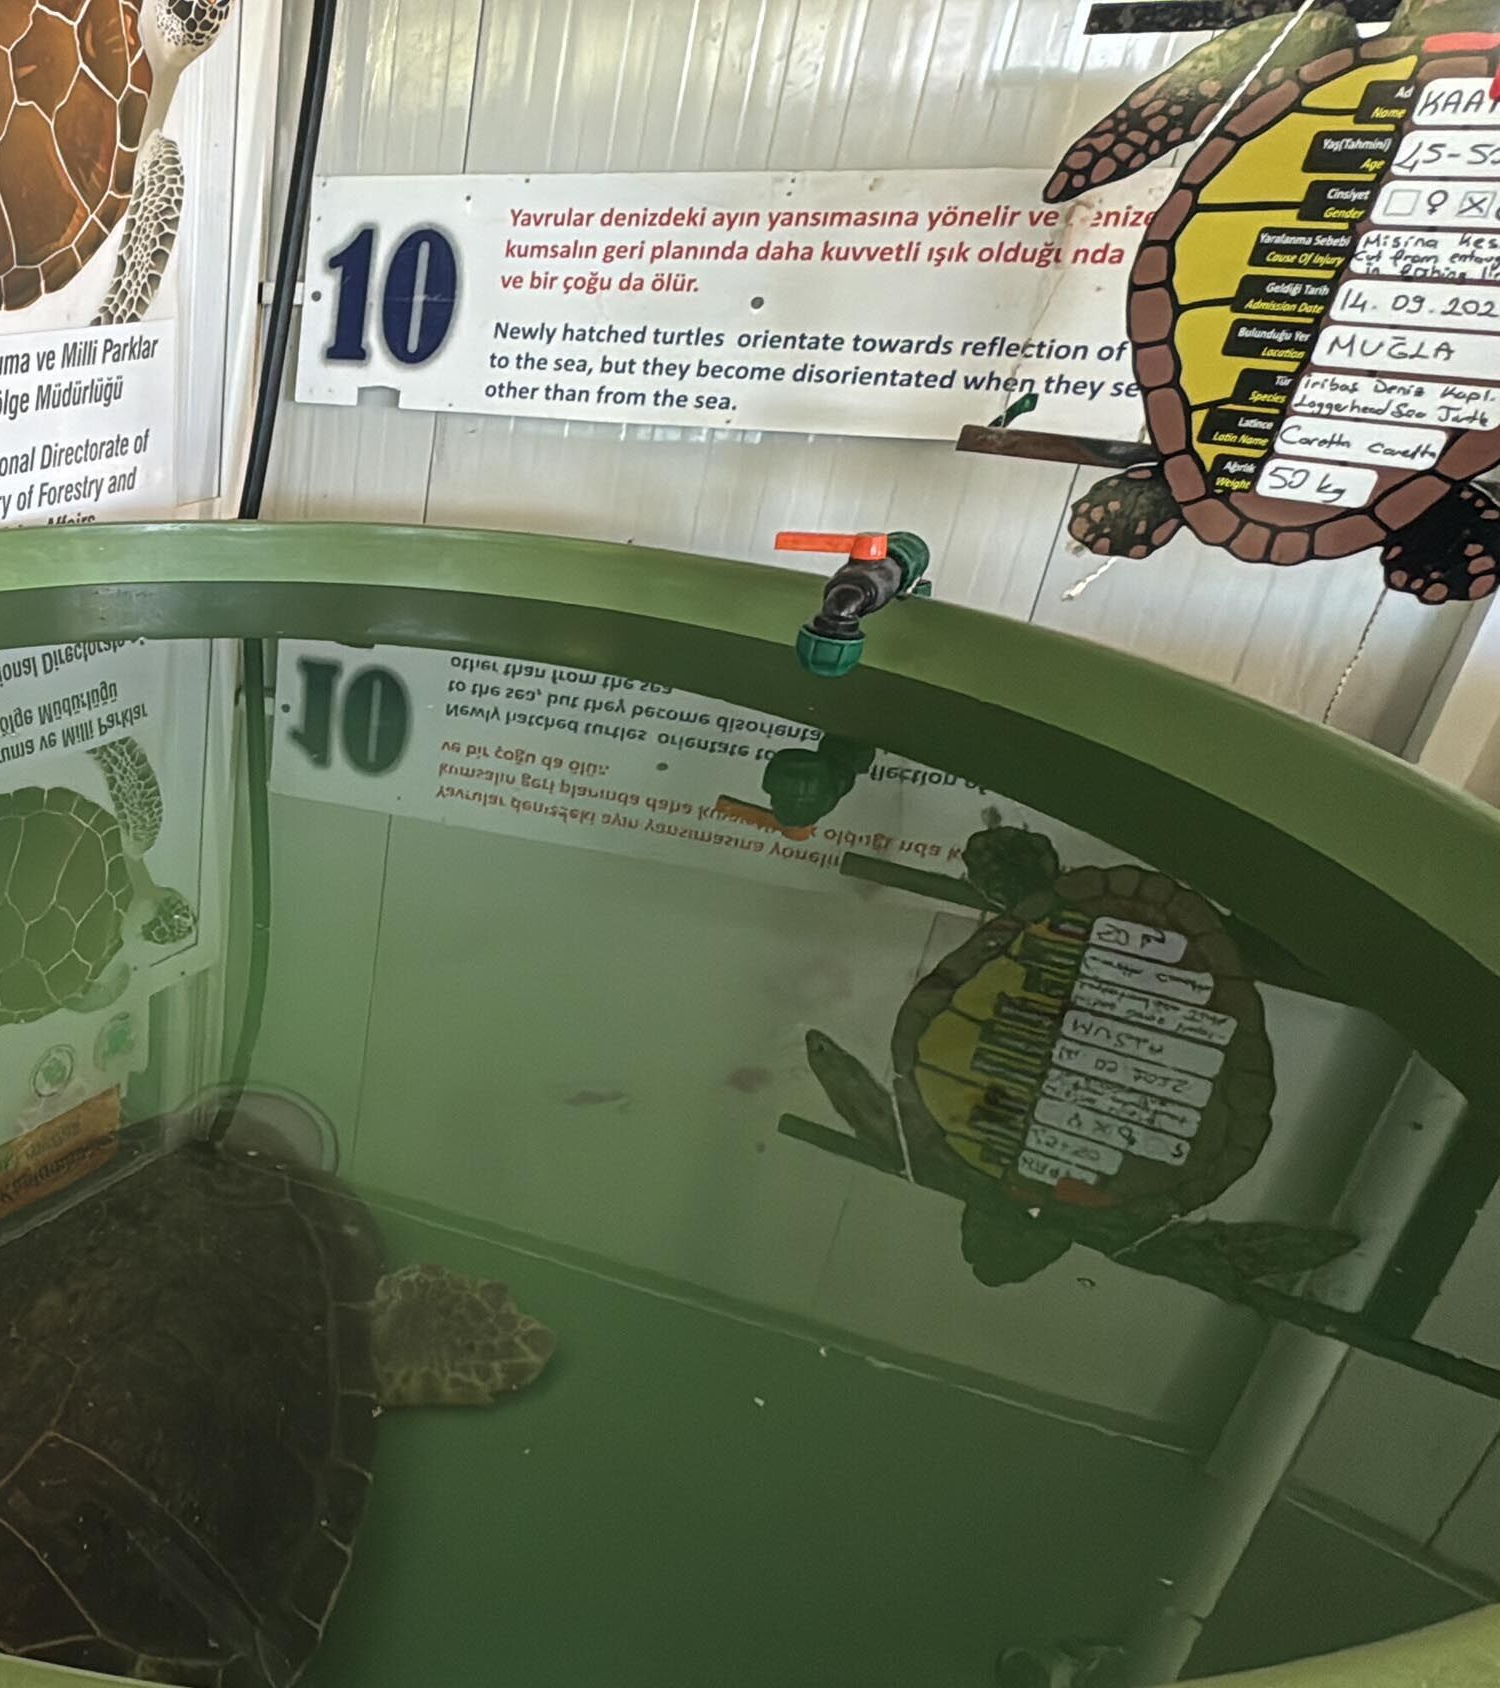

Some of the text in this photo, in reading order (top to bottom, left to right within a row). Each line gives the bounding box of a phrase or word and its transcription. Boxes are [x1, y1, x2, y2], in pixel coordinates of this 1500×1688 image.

[510, 208, 594, 228] Yavrular
[600, 207, 706, 228] denizdeki
[712, 210, 760, 232] ayın
[767, 207, 918, 231] yansımasına
[928, 206, 1020, 231] yönelir
[1028, 210, 1059, 227] ve
[505, 239, 596, 260] kumsalın
[602, 241, 645, 264] geri
[650, 240, 749, 264] planında
[756, 242, 814, 262] daha
[821, 241, 919, 262] kuvvetli
[927, 243, 969, 267] ışık
[326, 228, 457, 365] 10
[501, 271, 699, 296] ve bir çoğu da ölür.
[37, 349, 56, 371] ve
[61, 339, 98, 369] Milli
[102, 335, 159, 365] Parklar
[494, 322, 1128, 362] Newly hatched turtles orientate towards reflection of
[35, 375, 124, 412] Müdürlüğü
[490, 353, 1140, 401] to the sea, but they become disorientated when they se
[485, 381, 737, 412] other than from the sea.
[40, 436, 129, 471] Directorate
[133, 428, 151, 454] of
[16, 487, 34, 512] of
[38, 475, 104, 509] Forestry
[108, 466, 138, 493] and
